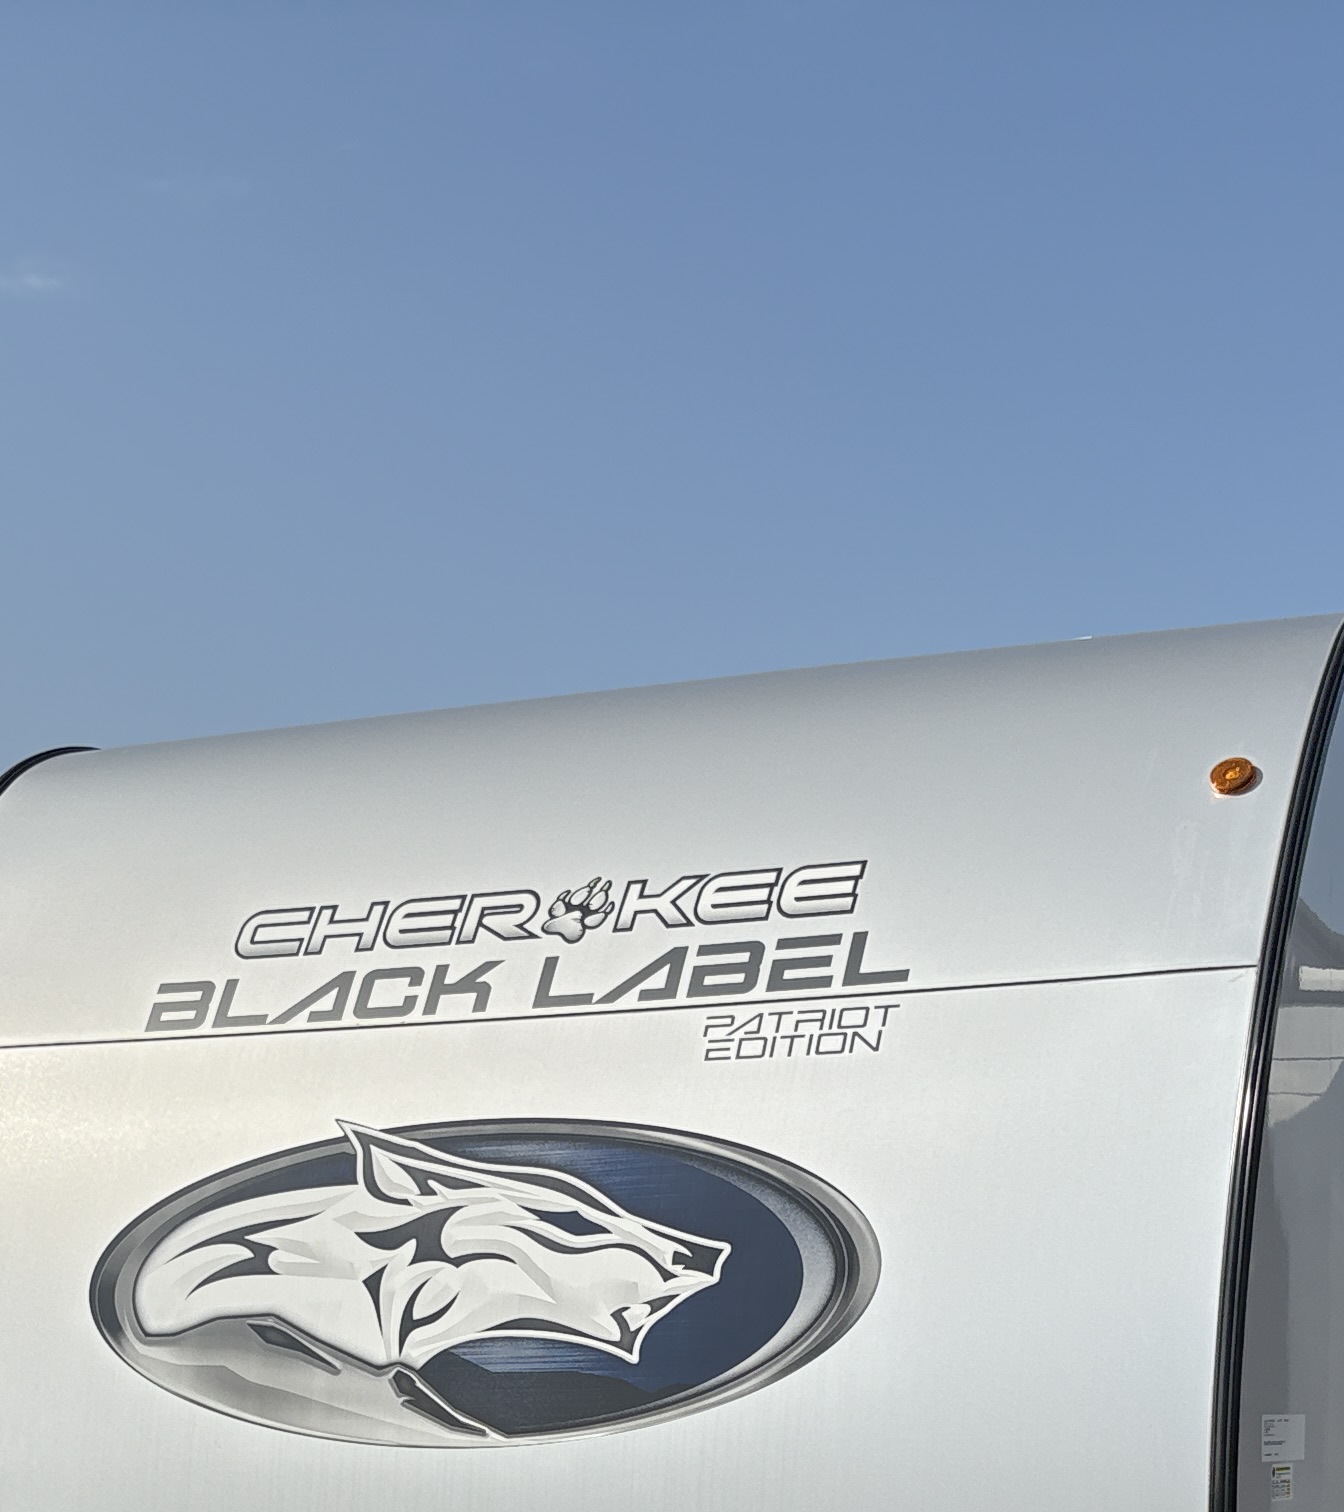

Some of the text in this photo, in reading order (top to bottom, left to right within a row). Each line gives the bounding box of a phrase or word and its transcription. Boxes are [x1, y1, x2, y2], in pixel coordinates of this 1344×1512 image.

[144, 930, 910, 1033] BLACK LABEL
[702, 1004, 901, 1039] PATRIOT
[702, 1030, 884, 1063] EDITION
